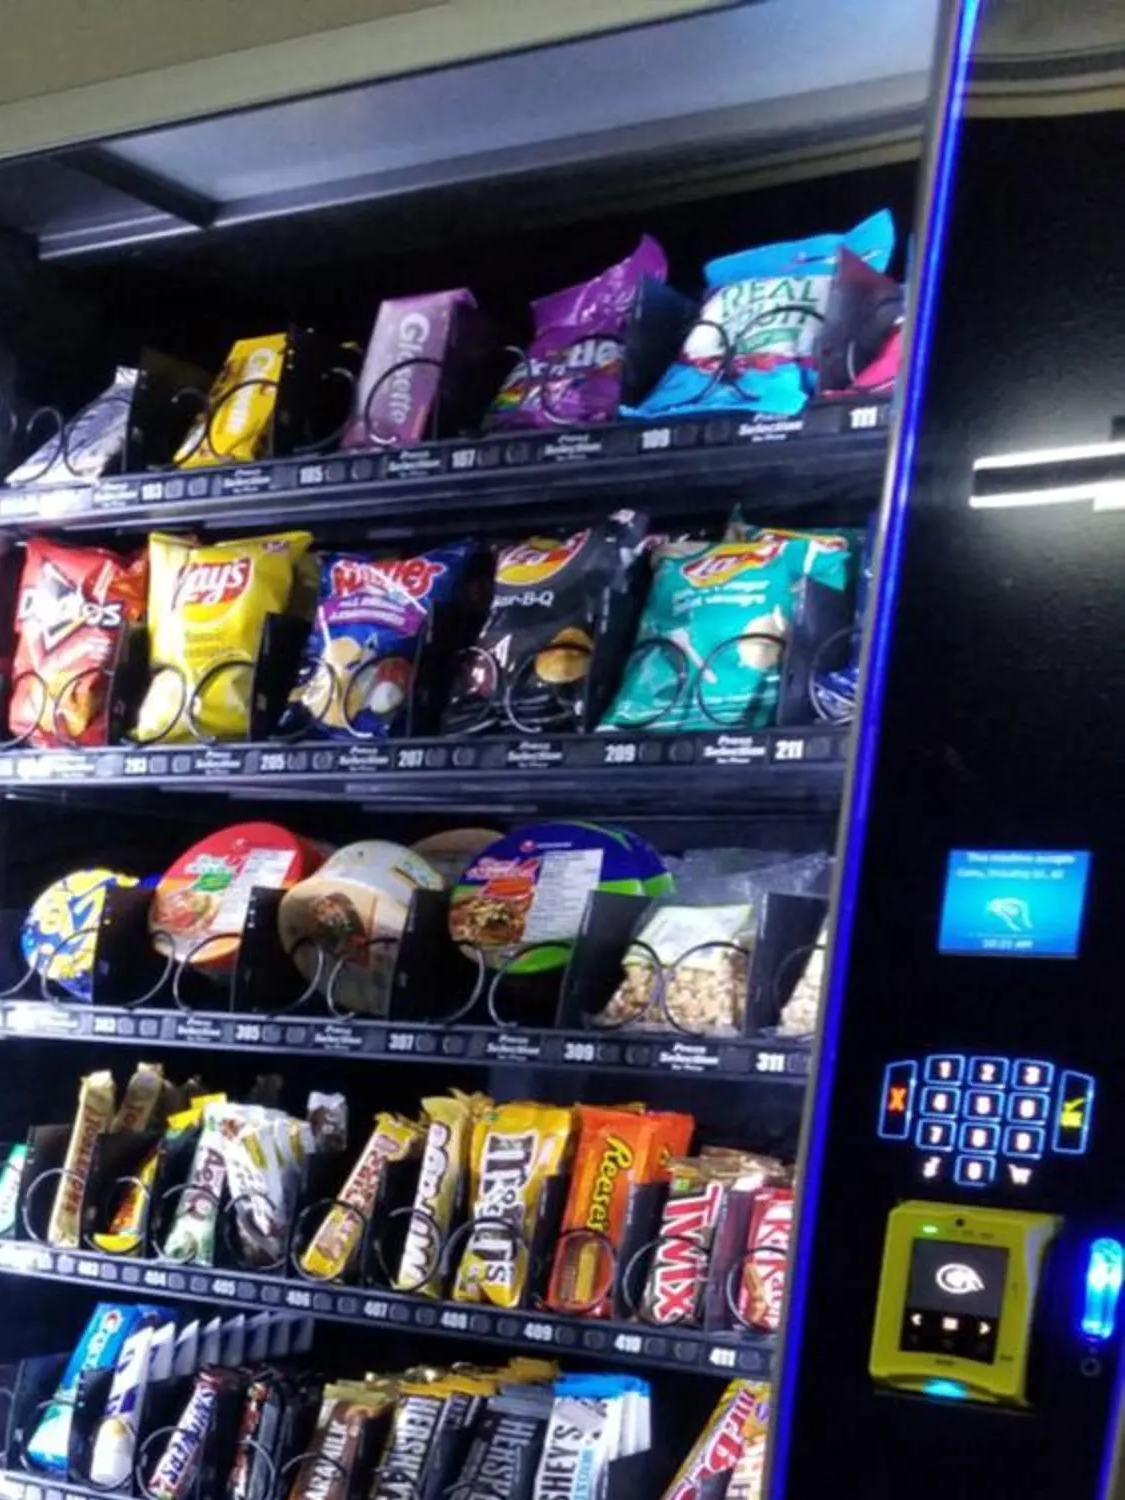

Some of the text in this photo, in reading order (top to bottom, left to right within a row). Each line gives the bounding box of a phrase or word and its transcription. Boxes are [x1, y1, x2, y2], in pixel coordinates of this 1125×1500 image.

[775, 740, 805, 760] 211
[756, 1053, 784, 1072] 311
[980, 1063, 995, 1082] 2
[1024, 1066, 1040, 1085] 3
[930, 1126, 943, 1144] 7
[653, 1181, 724, 1326] TWIX
